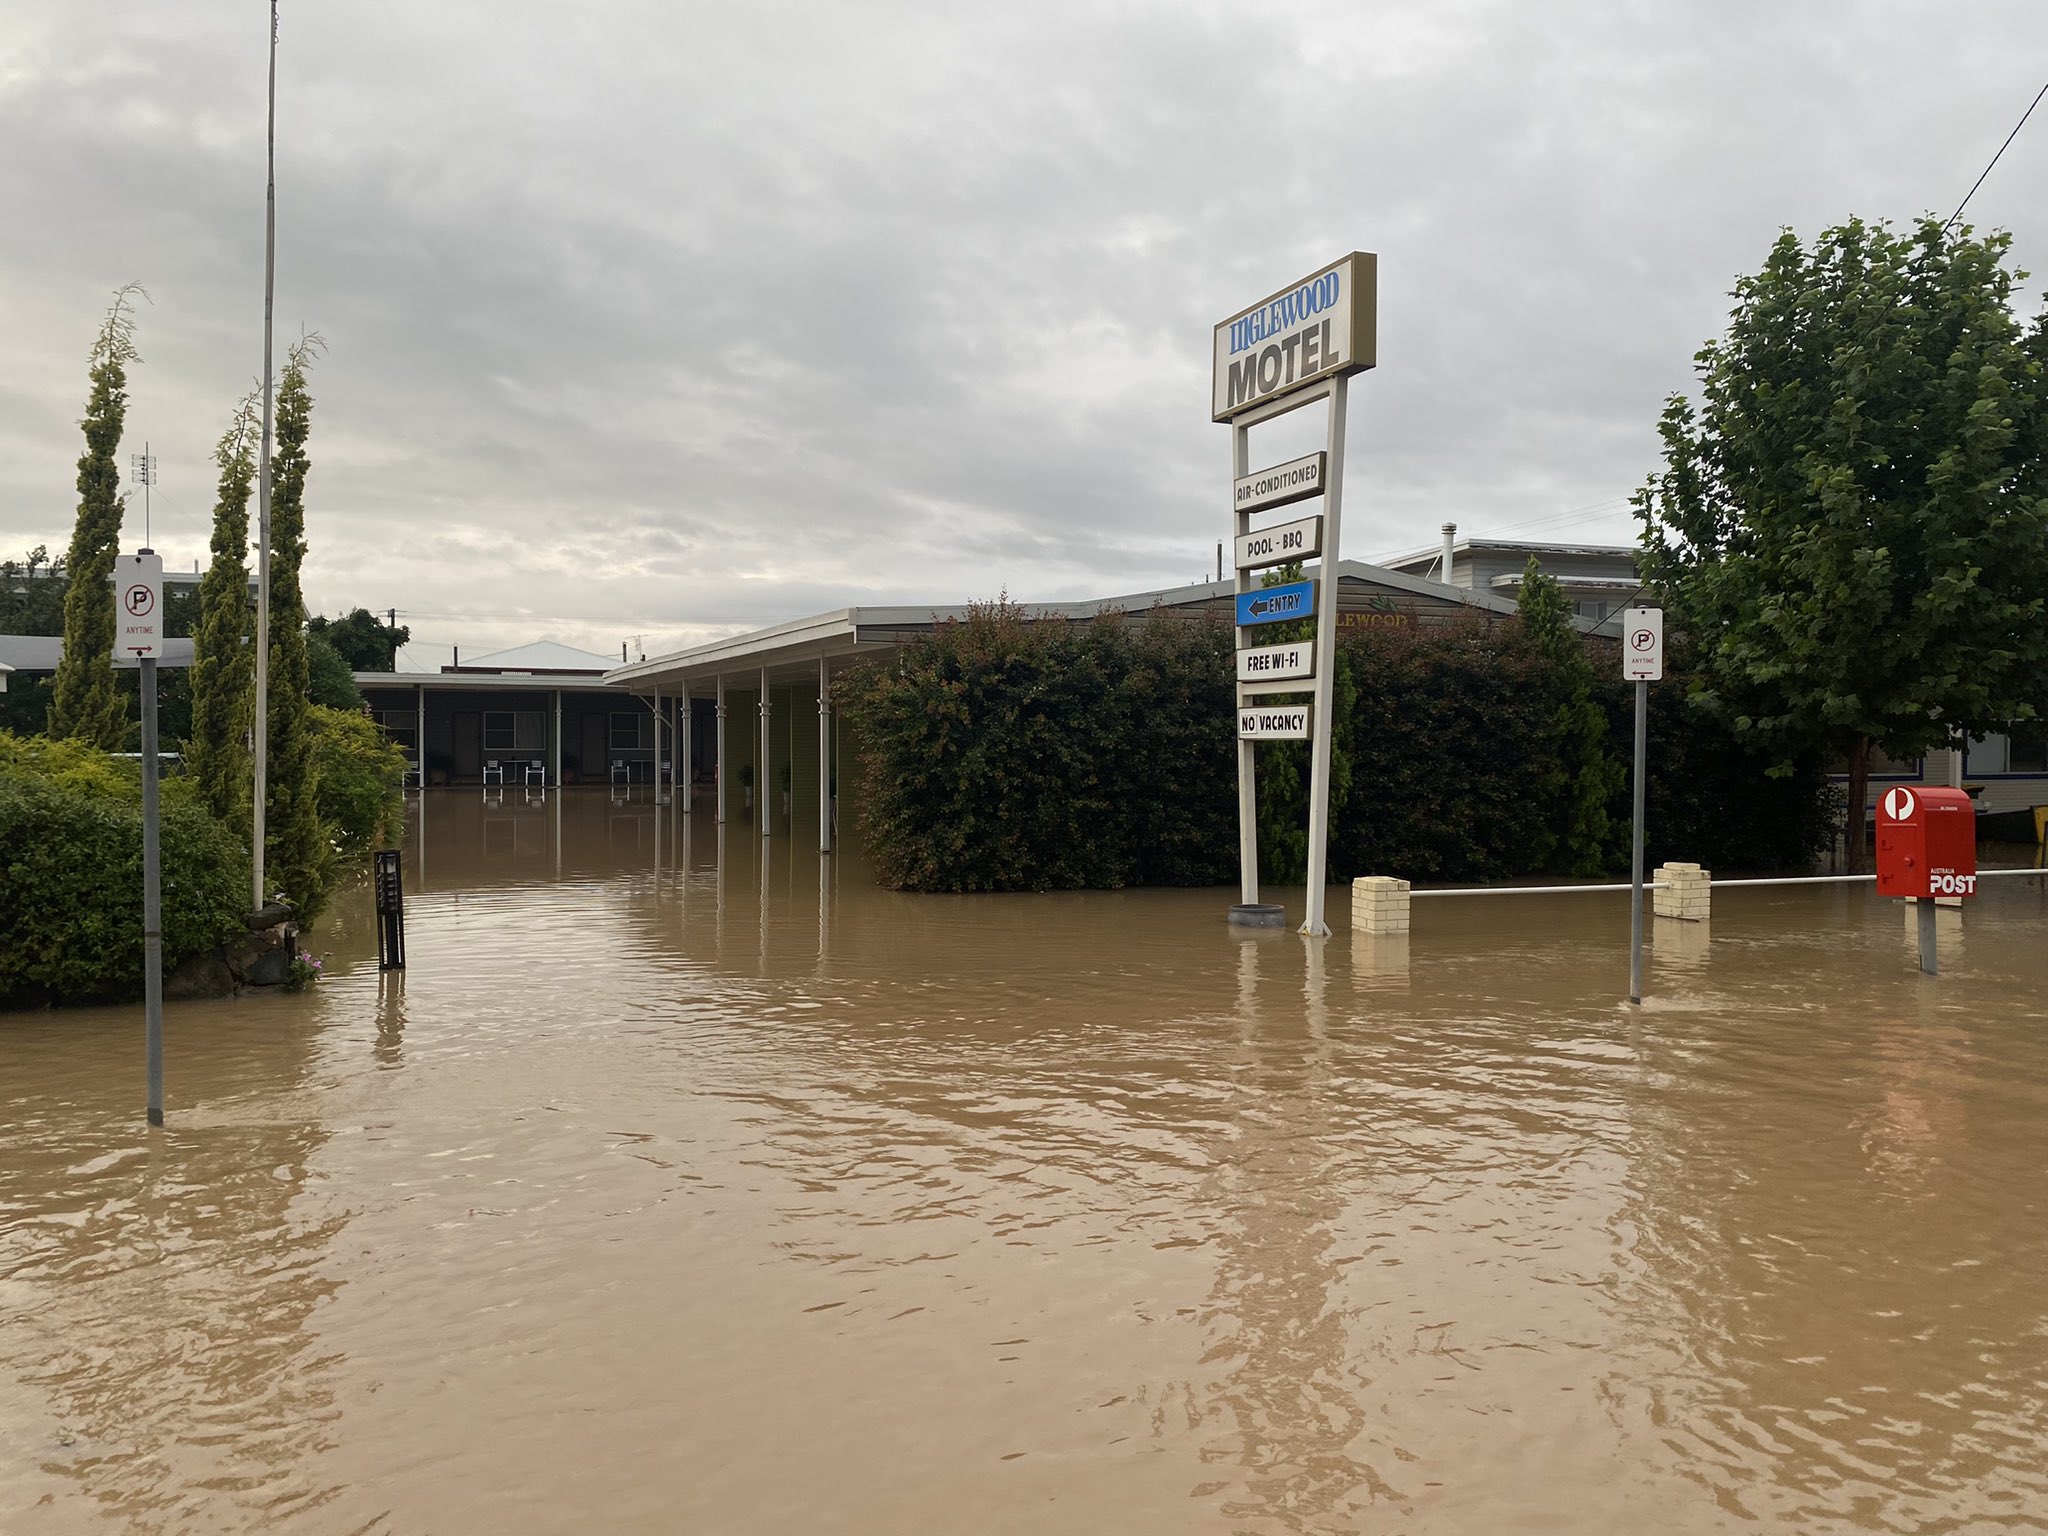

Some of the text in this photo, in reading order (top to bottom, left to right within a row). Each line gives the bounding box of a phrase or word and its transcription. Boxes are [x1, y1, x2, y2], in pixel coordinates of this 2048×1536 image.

[1229, 271, 1340, 355] INGLEWOOD
[1227, 317, 1340, 409] MOTEL
[1237, 464, 1317, 502] AIR-CONDITIONED
[1247, 537, 1273, 558] POOL
[1282, 530, 1303, 549] BBQ
[1269, 593, 1301, 614] ENTRY
[126, 626, 154, 634] ANYTIME
[1248, 652, 1298, 671] FREE WI-FI
[1242, 715, 1304, 731] NO VACANCY
[1930, 875, 1976, 893] POST
